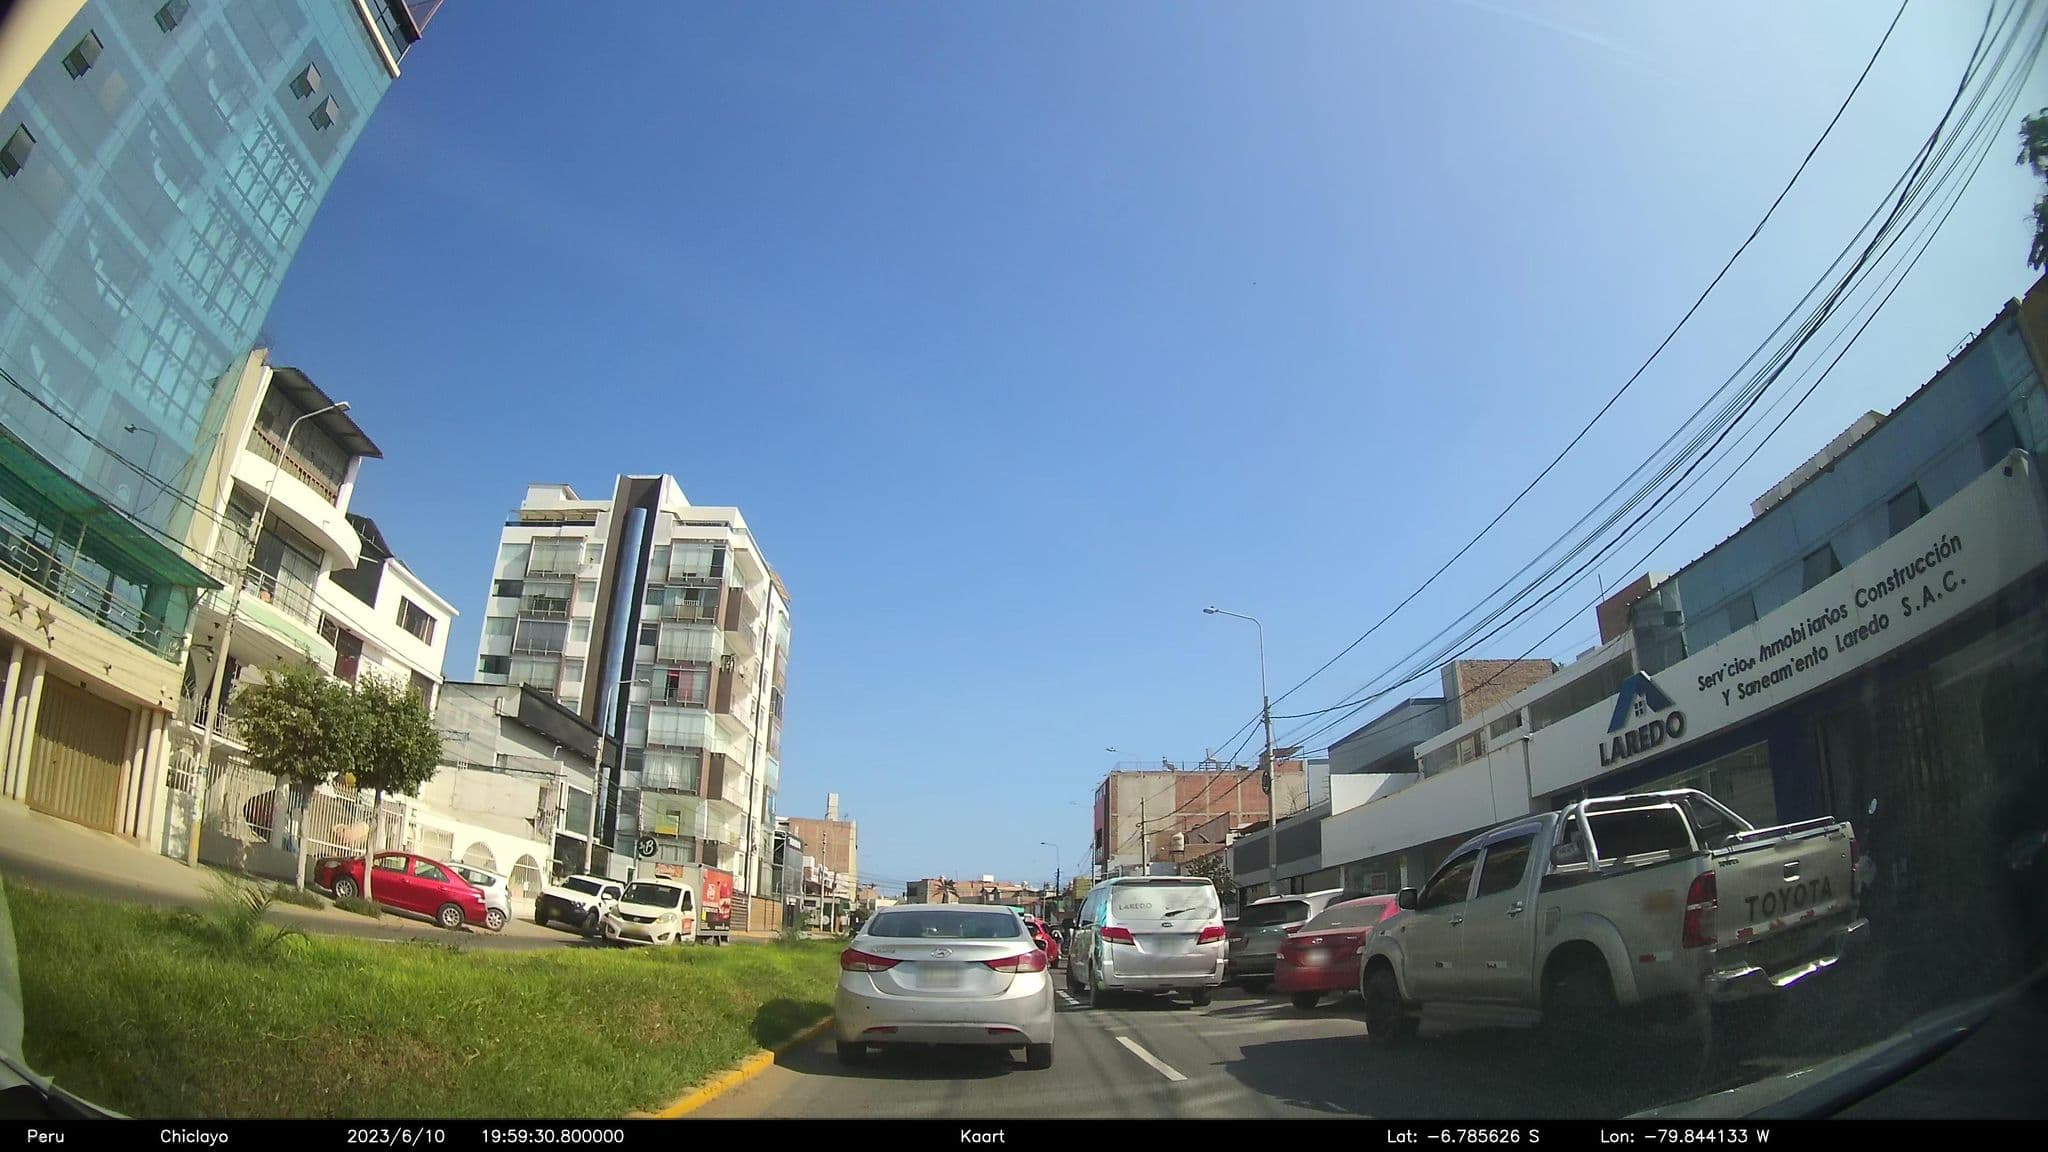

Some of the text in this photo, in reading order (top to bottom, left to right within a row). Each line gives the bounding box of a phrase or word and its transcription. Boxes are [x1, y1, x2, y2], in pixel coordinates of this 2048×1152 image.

[1697, 534, 1962, 692] Servcios Inmobiiarios Construcción
[1721, 570, 1966, 707] Y Saneamento Laredo S.A.C.
[1599, 711, 1687, 767] LAREDO
[1744, 875, 1833, 922] TOYOTA
